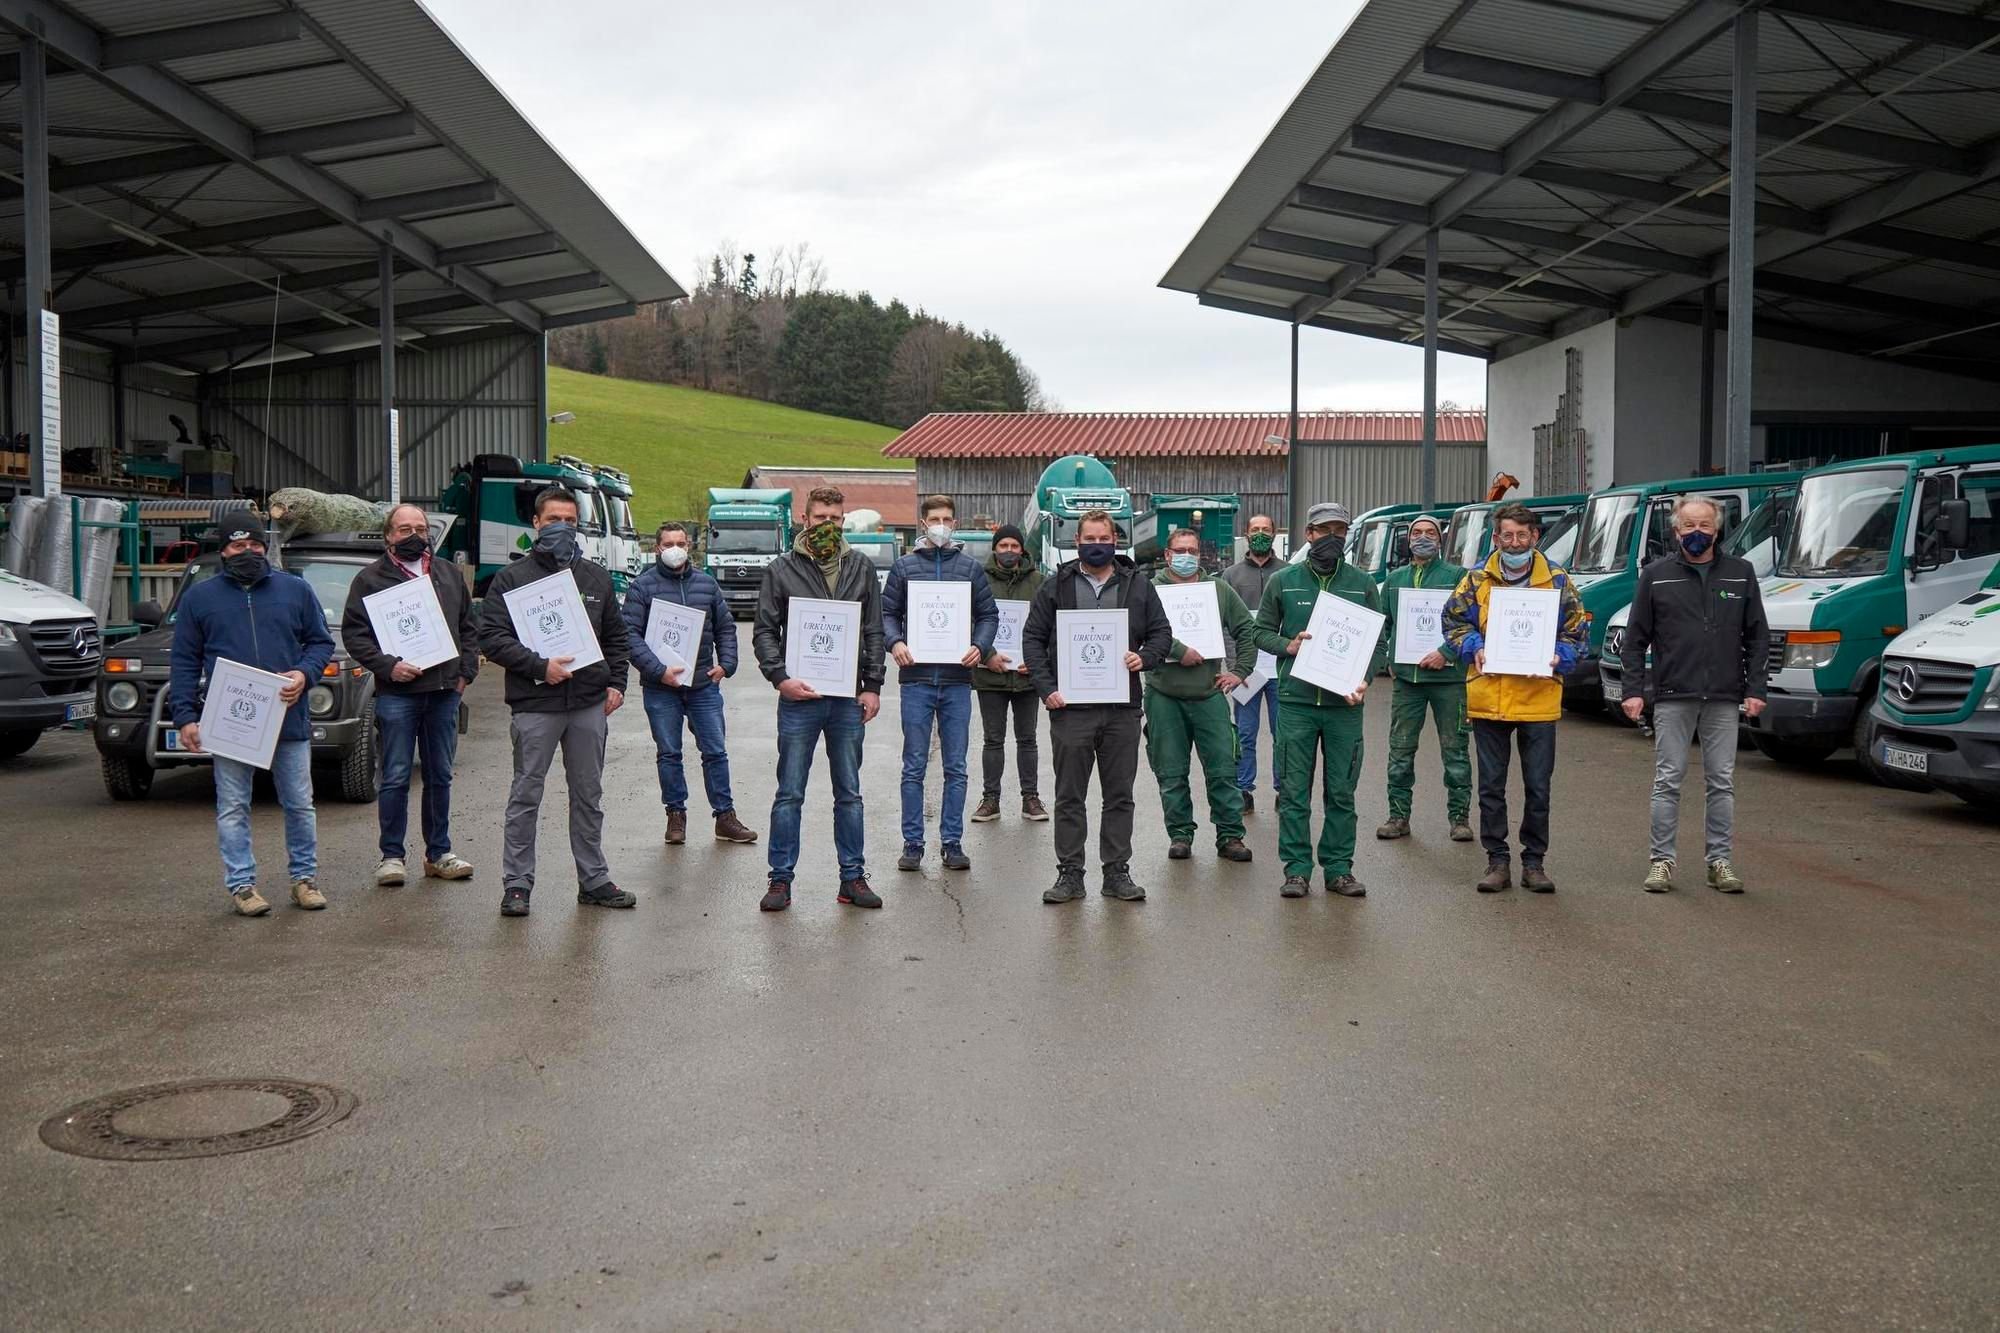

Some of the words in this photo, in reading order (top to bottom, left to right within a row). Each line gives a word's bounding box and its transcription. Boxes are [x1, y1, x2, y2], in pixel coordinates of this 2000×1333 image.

[385, 601, 423, 620] URKUNDE
[526, 596, 563, 617] URKUNDE
[1504, 608, 1543, 617] URKUNDE
[401, 616, 415, 628] 20
[545, 614, 557, 626] 20
[1326, 616, 1362, 636] URKUNDE
[803, 622, 844, 632] URKUNDE
[668, 631, 677, 640] 15
[816, 635, 829, 645] 20
[1073, 633, 1113, 642] URKUNDE
[1089, 646, 1096, 655] 5
[226, 684, 270, 704] URKUNDE
[239, 700, 250, 712] 15
[1909, 754, 1926, 770] 246
